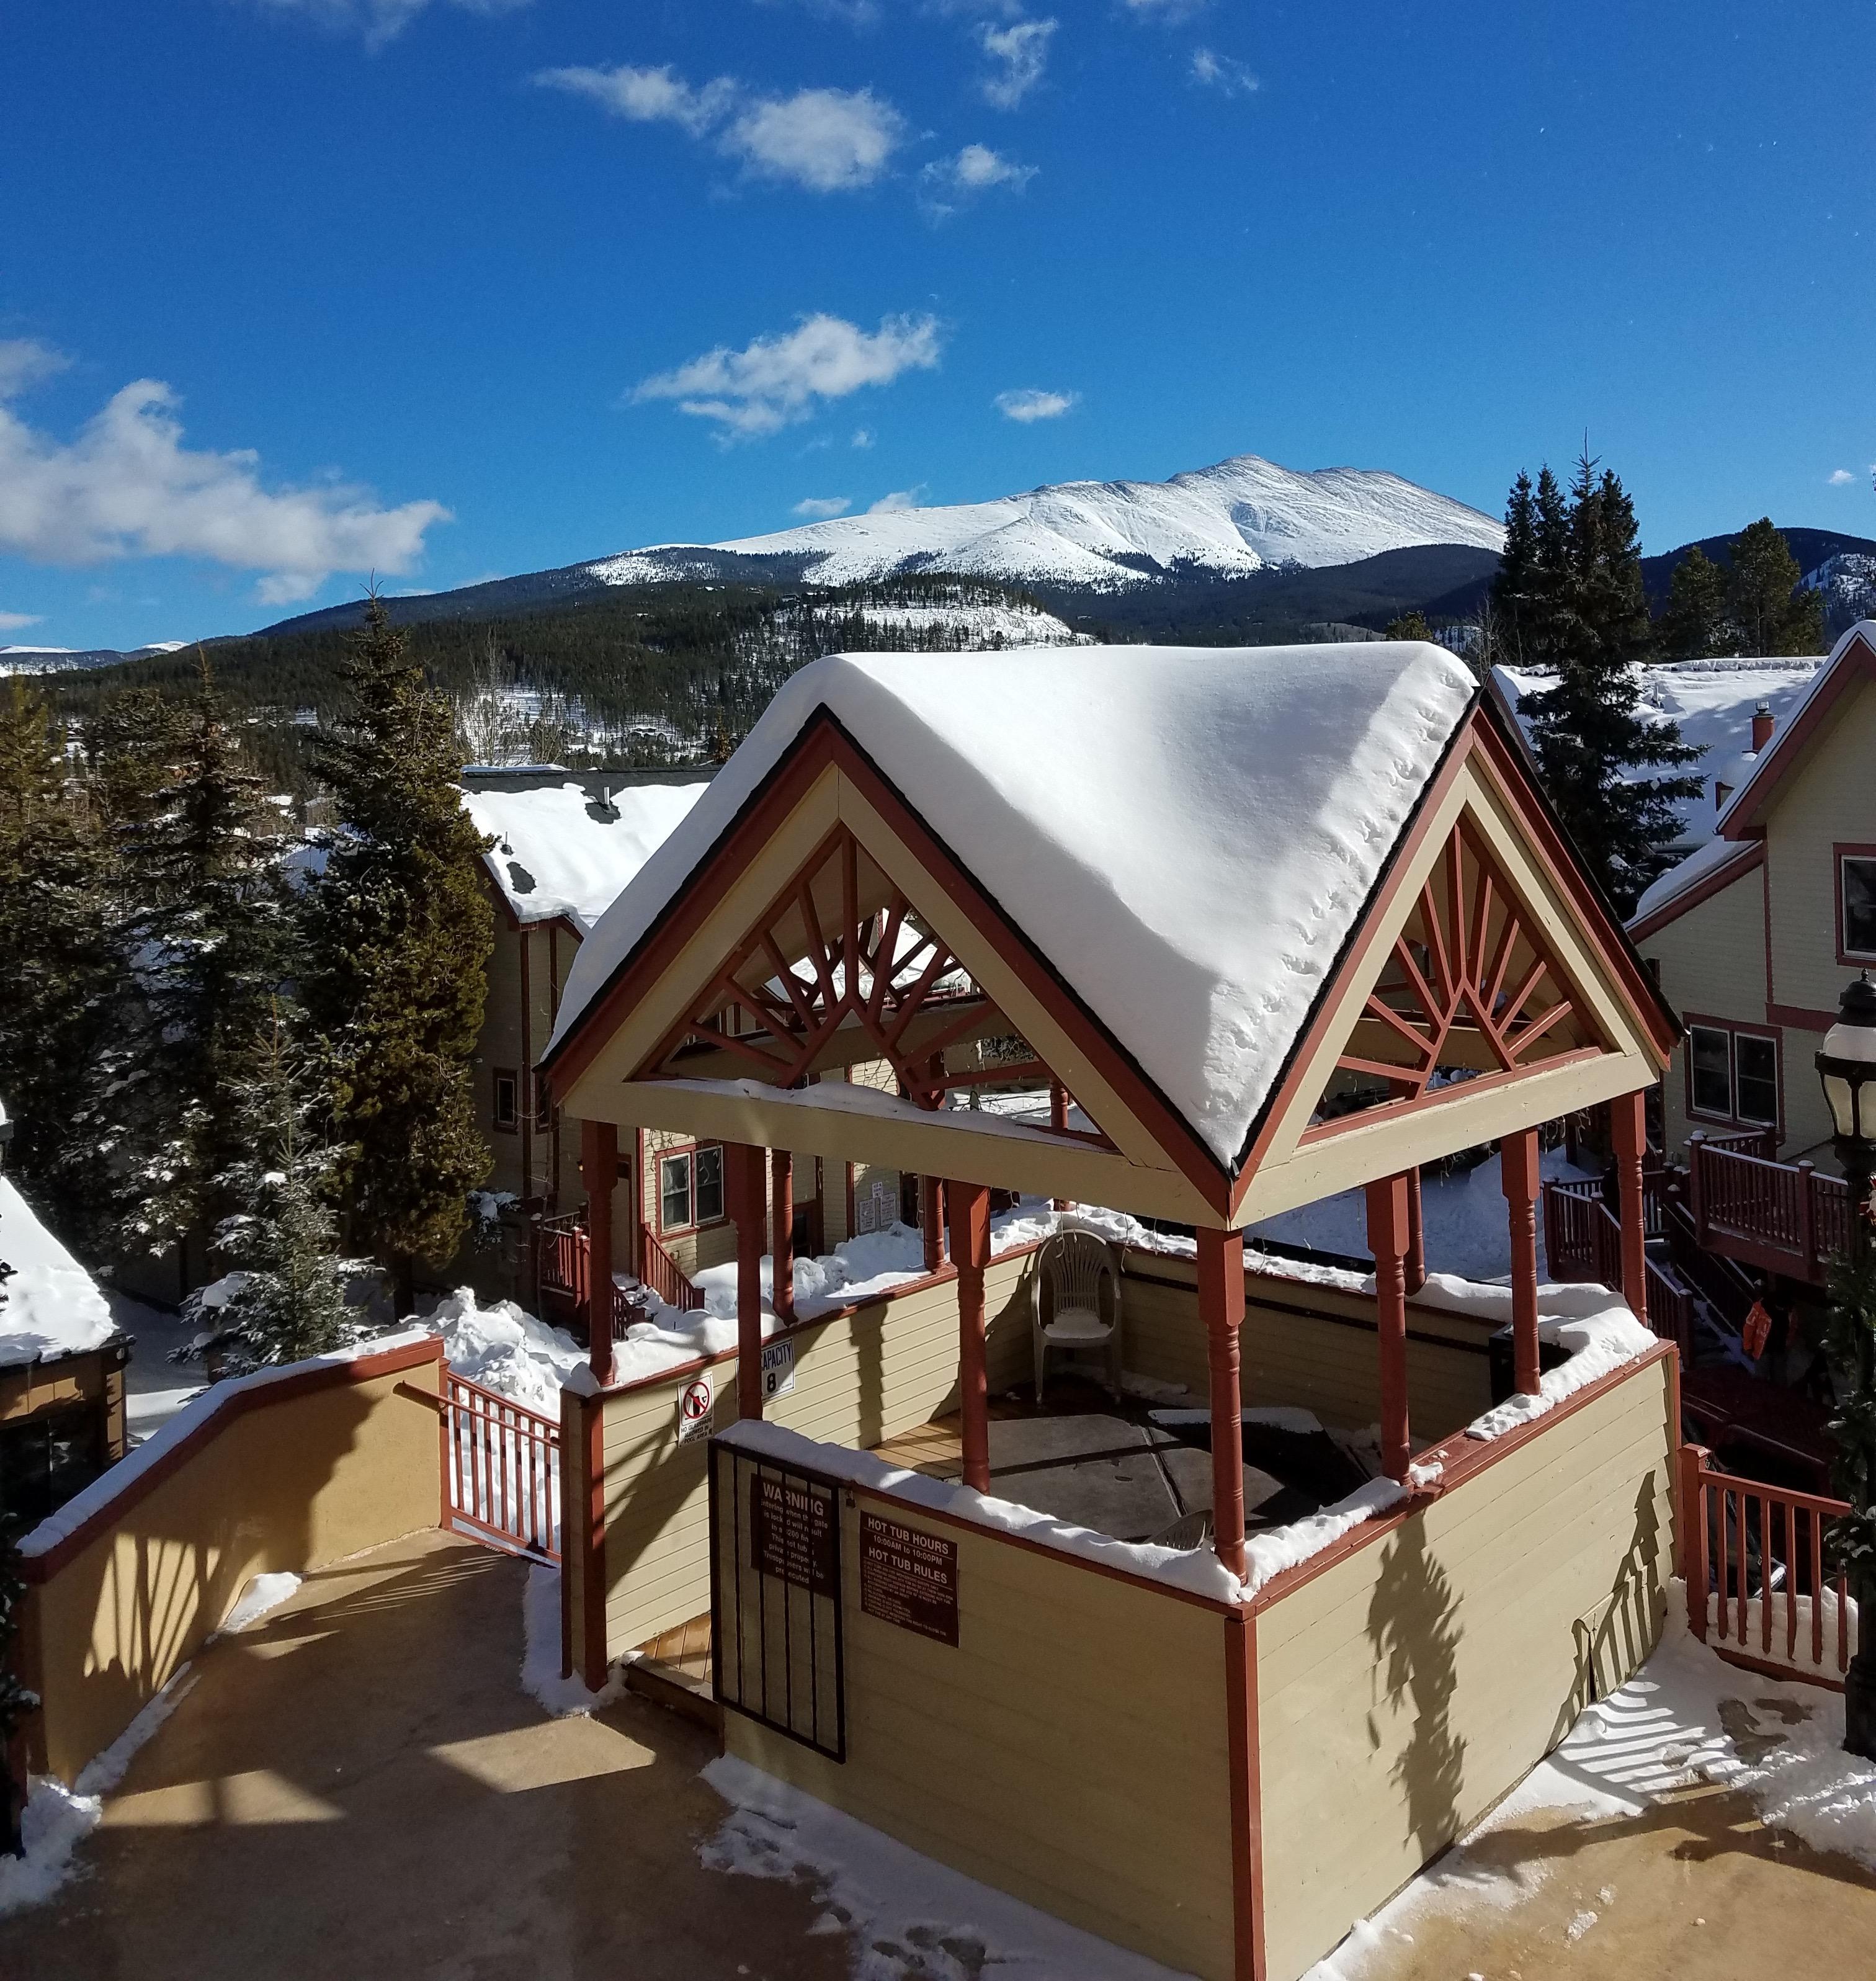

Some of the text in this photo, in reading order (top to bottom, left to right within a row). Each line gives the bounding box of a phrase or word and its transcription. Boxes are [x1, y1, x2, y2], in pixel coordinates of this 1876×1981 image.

[762, 1343, 791, 1371] APACITY
[767, 1372, 776, 1393] 8
[763, 1482, 824, 1517] WARNING
[761, 1498, 784, 1514] ntering
[814, 1519, 828, 1529] gate
[764, 1509, 770, 1518] is
[770, 1512, 790, 1526] lockd
[792, 1521, 803, 1530] will
[771, 1532, 784, 1544] This
[797, 1542, 808, 1553] tub
[801, 1534, 815, 1545] fin.
[868, 1517, 949, 1555] HOT TUB HOURS
[769, 1544, 789, 1555] priva
[873, 1534, 942, 1565] 10:00AM to 10:00PM
[775, 1567, 809, 1584] proecuted
[816, 1570, 824, 1579] be
[869, 1546, 947, 1584] HOT TUB RULES
